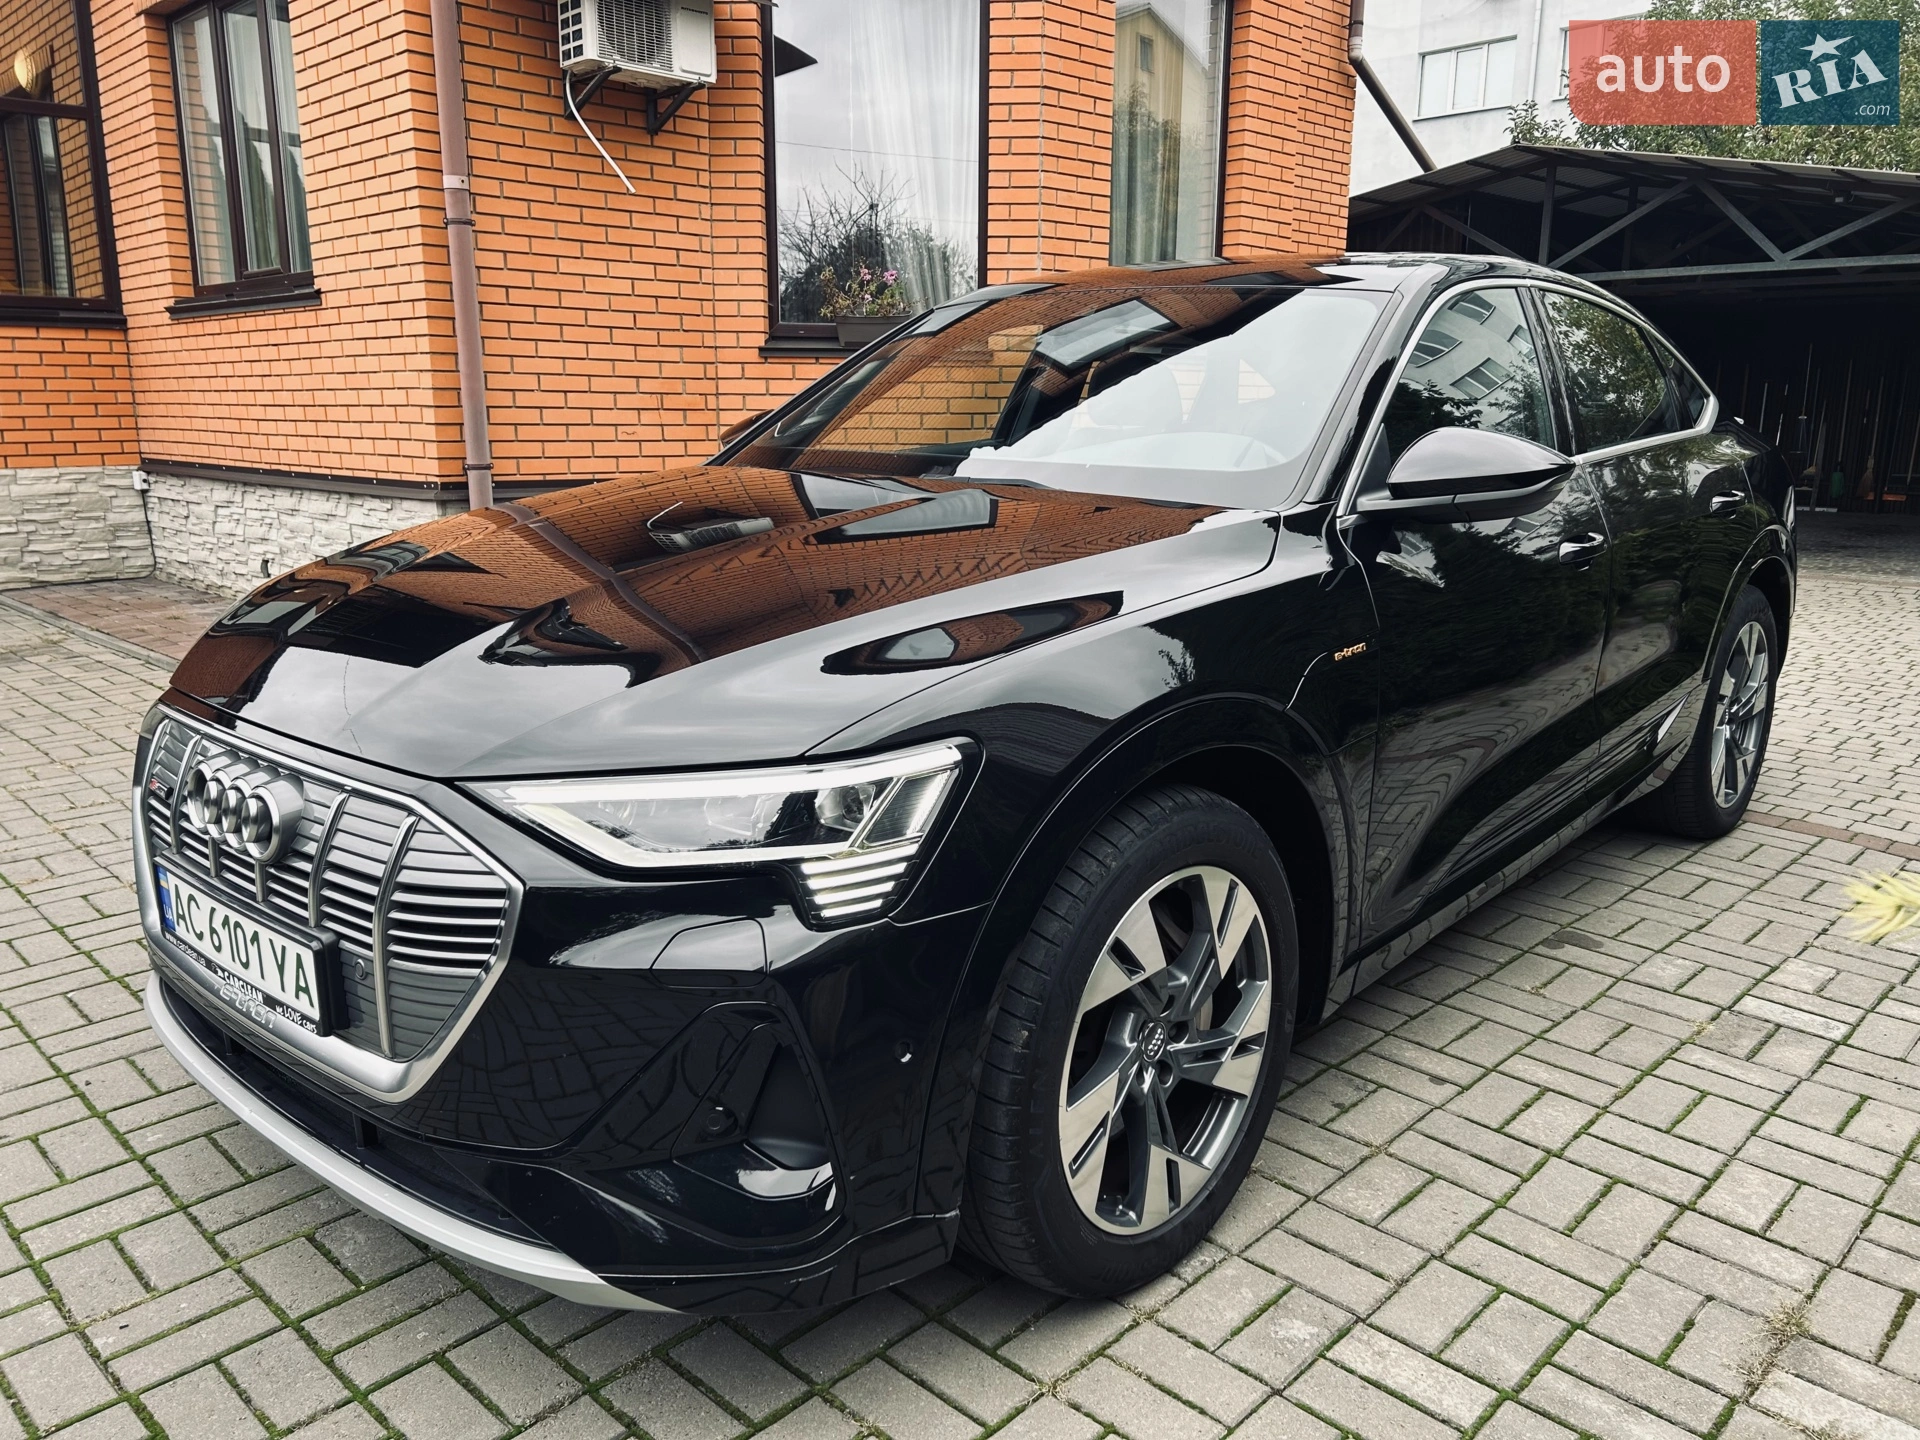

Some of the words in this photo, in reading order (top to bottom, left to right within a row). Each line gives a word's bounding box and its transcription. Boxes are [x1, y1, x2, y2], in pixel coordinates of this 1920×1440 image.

[163, 904, 174, 922] UA
[174, 884, 204, 942] AC
[208, 906, 265, 981] 6101
[268, 938, 315, 1008] YA
[224, 971, 264, 1004] CARCLEAN
[283, 1005, 302, 1025] LOVE
[302, 1020, 317, 1034] cars
